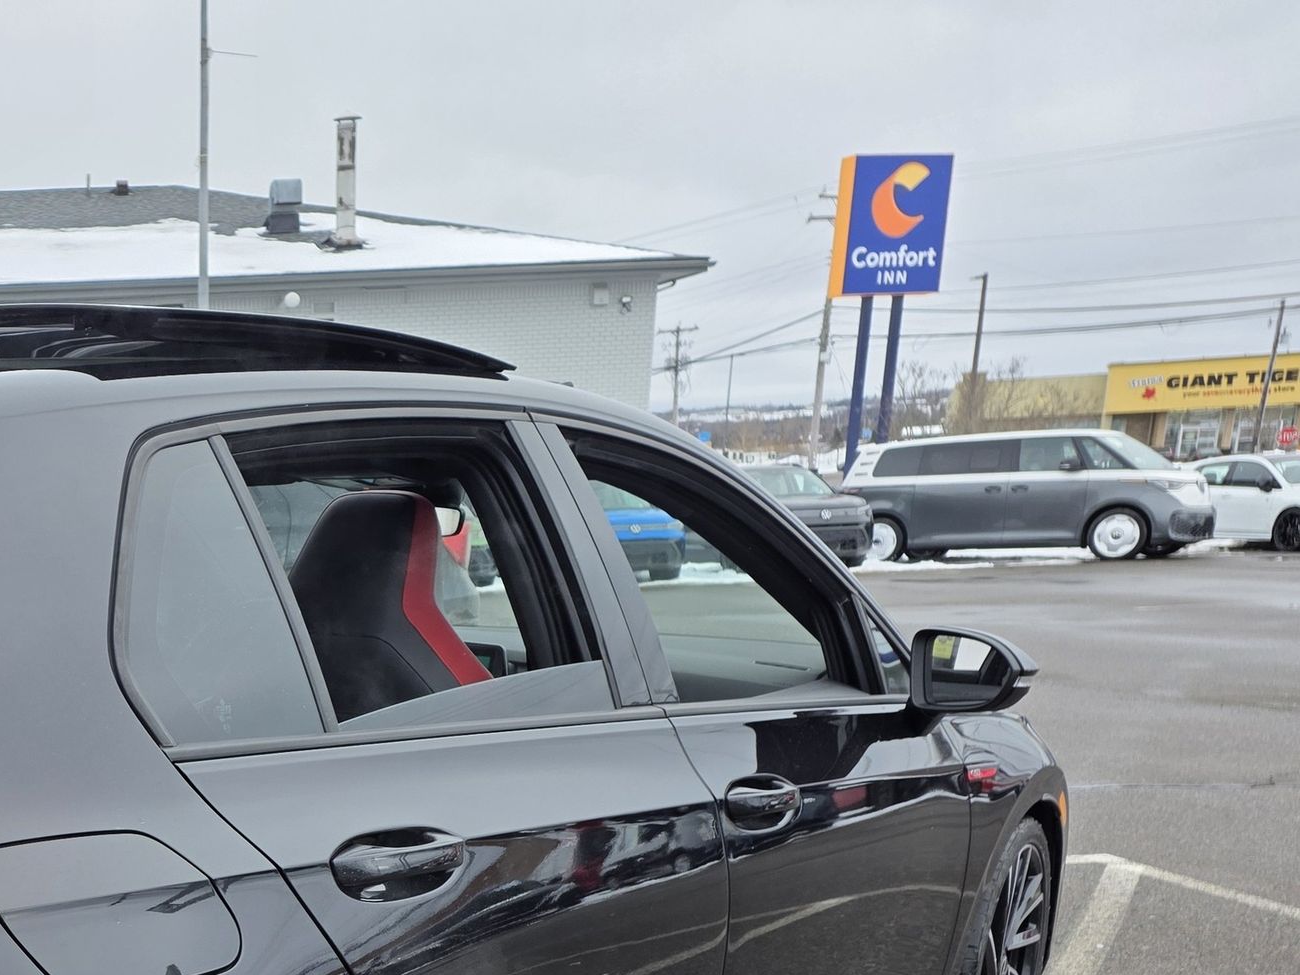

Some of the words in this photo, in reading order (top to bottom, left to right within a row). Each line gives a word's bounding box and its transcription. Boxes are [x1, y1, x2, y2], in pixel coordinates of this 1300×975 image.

[851, 244, 937, 268] Comfort
[876, 270, 908, 285] INN
[1166, 372, 1238, 389] GIANT
